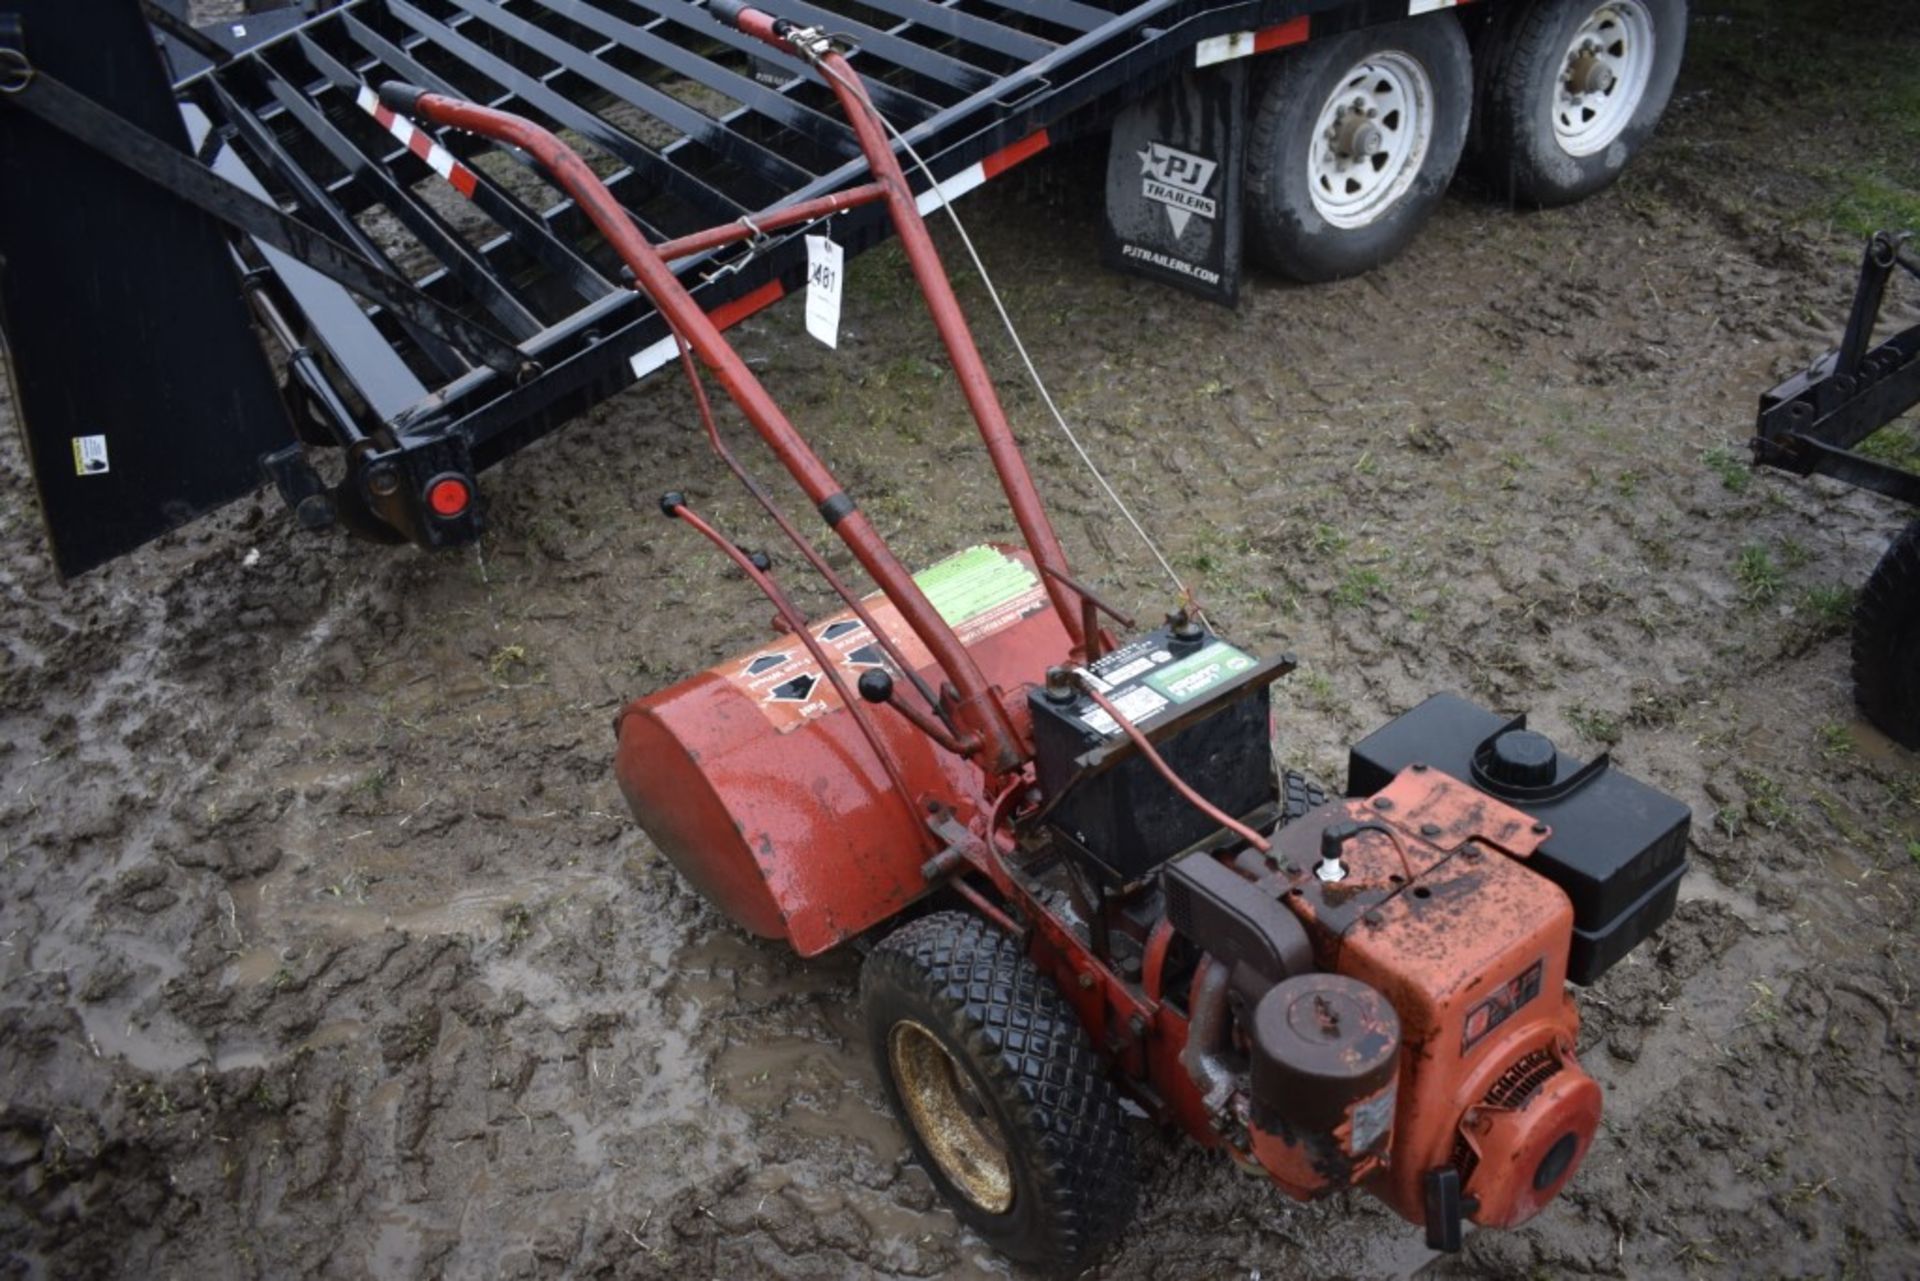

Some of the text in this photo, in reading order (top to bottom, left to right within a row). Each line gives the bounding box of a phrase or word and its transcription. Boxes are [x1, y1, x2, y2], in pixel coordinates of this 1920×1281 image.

[1164, 155, 1202, 185] PJ
[1146, 182, 1213, 213] TRAILERS
[1122, 244, 1220, 285] PJTRAILERS.COM
